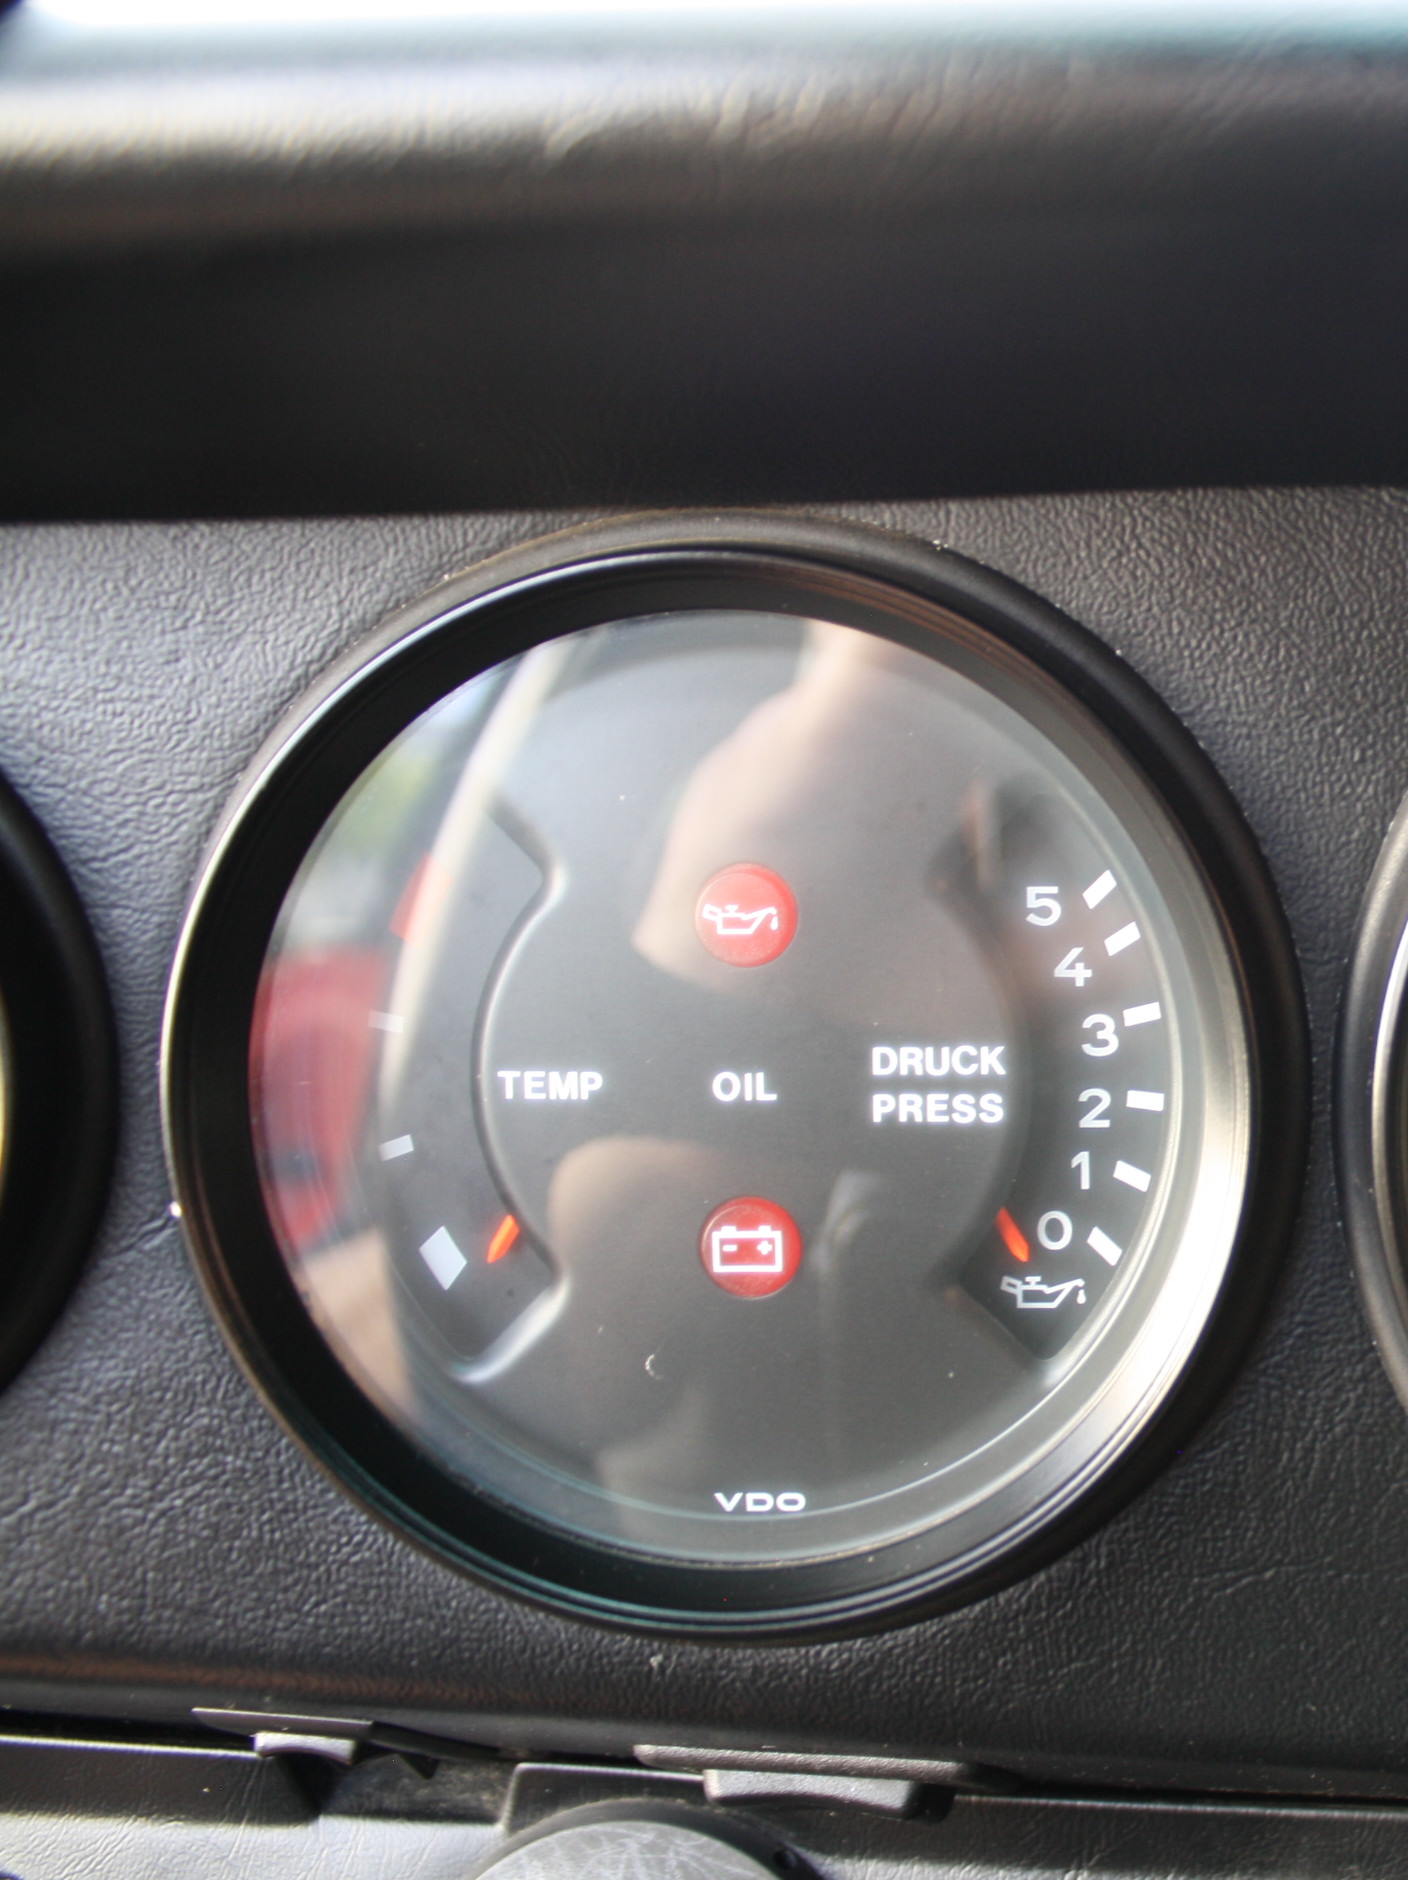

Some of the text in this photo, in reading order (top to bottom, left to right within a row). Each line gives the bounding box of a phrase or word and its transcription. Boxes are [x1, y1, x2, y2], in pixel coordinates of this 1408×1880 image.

[1026, 885, 1062, 927] 5
[1053, 946, 1093, 987] 4
[1081, 1013, 1120, 1057] 3
[871, 1044, 1007, 1077] DRUCK
[496, 1070, 604, 1101] TEMP
[711, 1070, 778, 1103] OIL
[872, 1092, 1005, 1125] PRESS
[1078, 1087, 1112, 1129] 2
[1071, 1150, 1091, 1190] 1
[1037, 1210, 1073, 1251] 0
[714, 1492, 807, 1512] VDO
